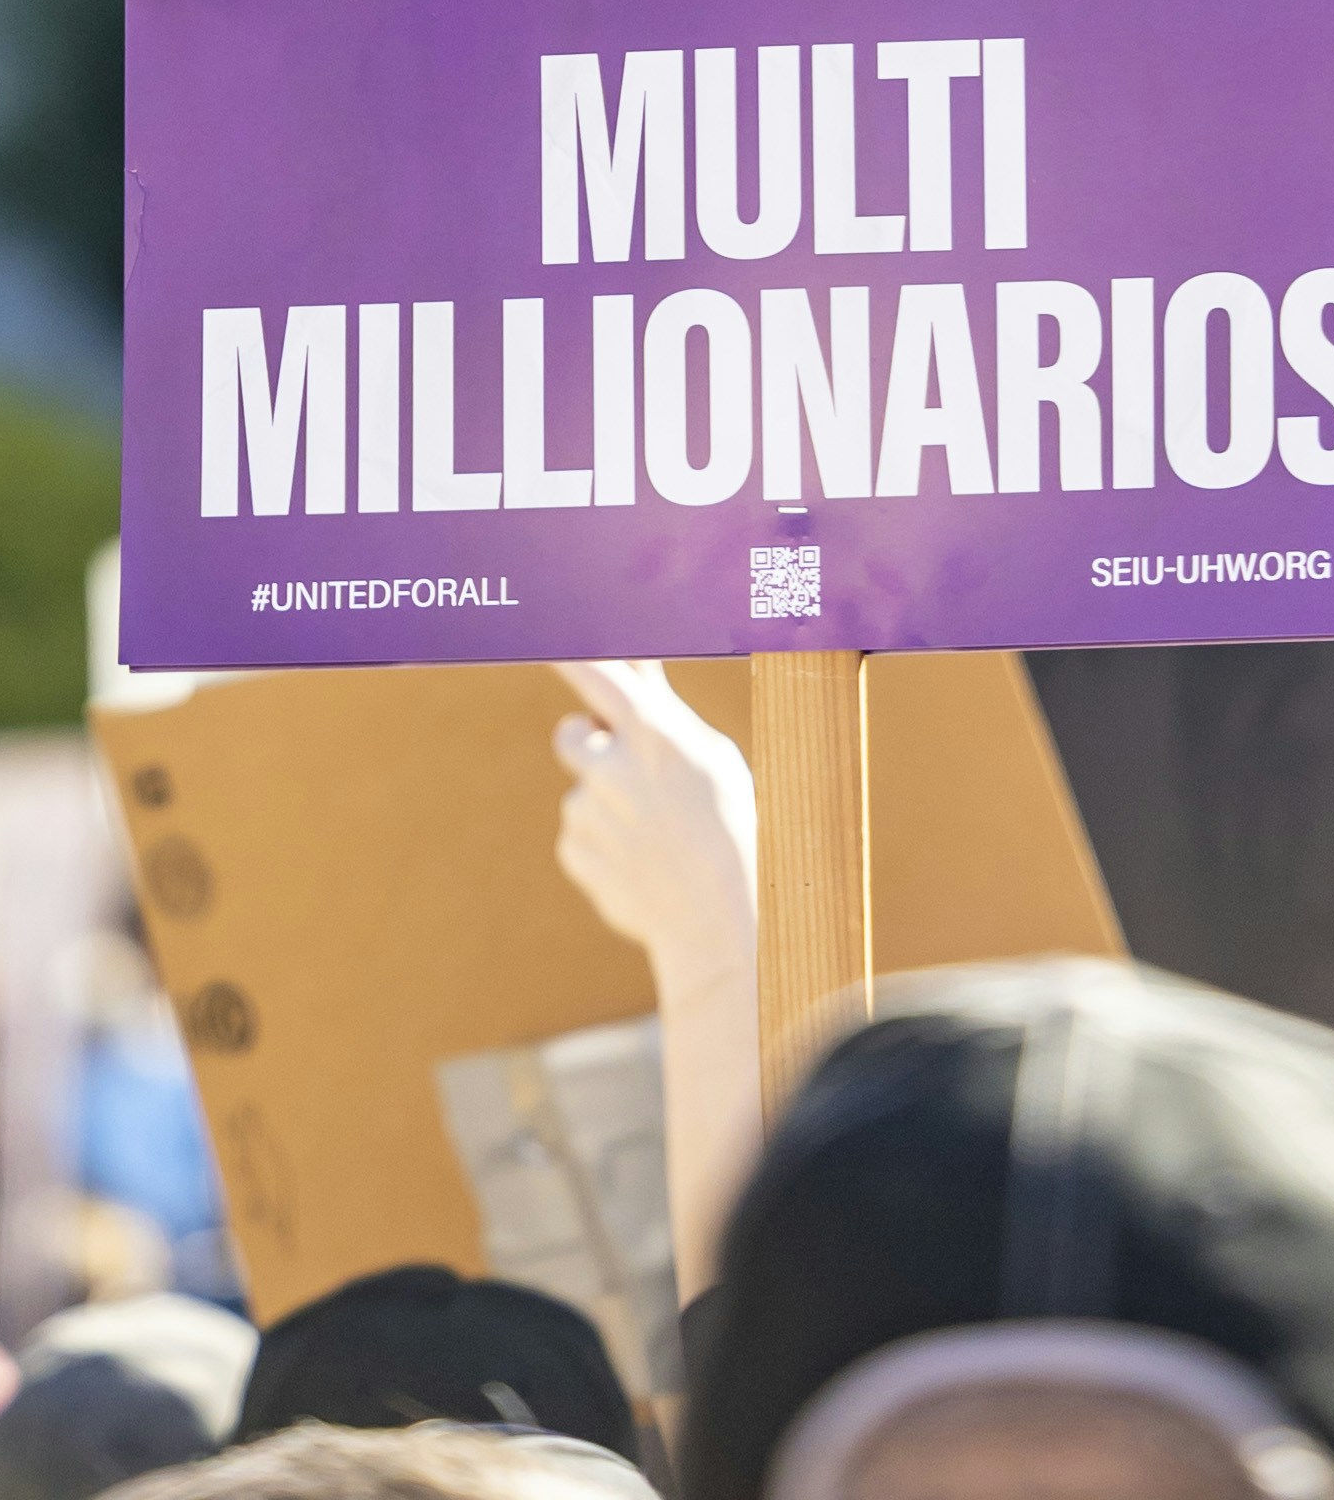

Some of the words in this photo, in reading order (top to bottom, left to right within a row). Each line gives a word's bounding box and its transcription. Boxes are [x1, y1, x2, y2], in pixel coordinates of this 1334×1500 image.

[539, 37, 1028, 265] MULTI
[1090, 549, 1332, 589] SEIU-UHW.ORG
[250, 576, 519, 612] #UNITEDFORALL
